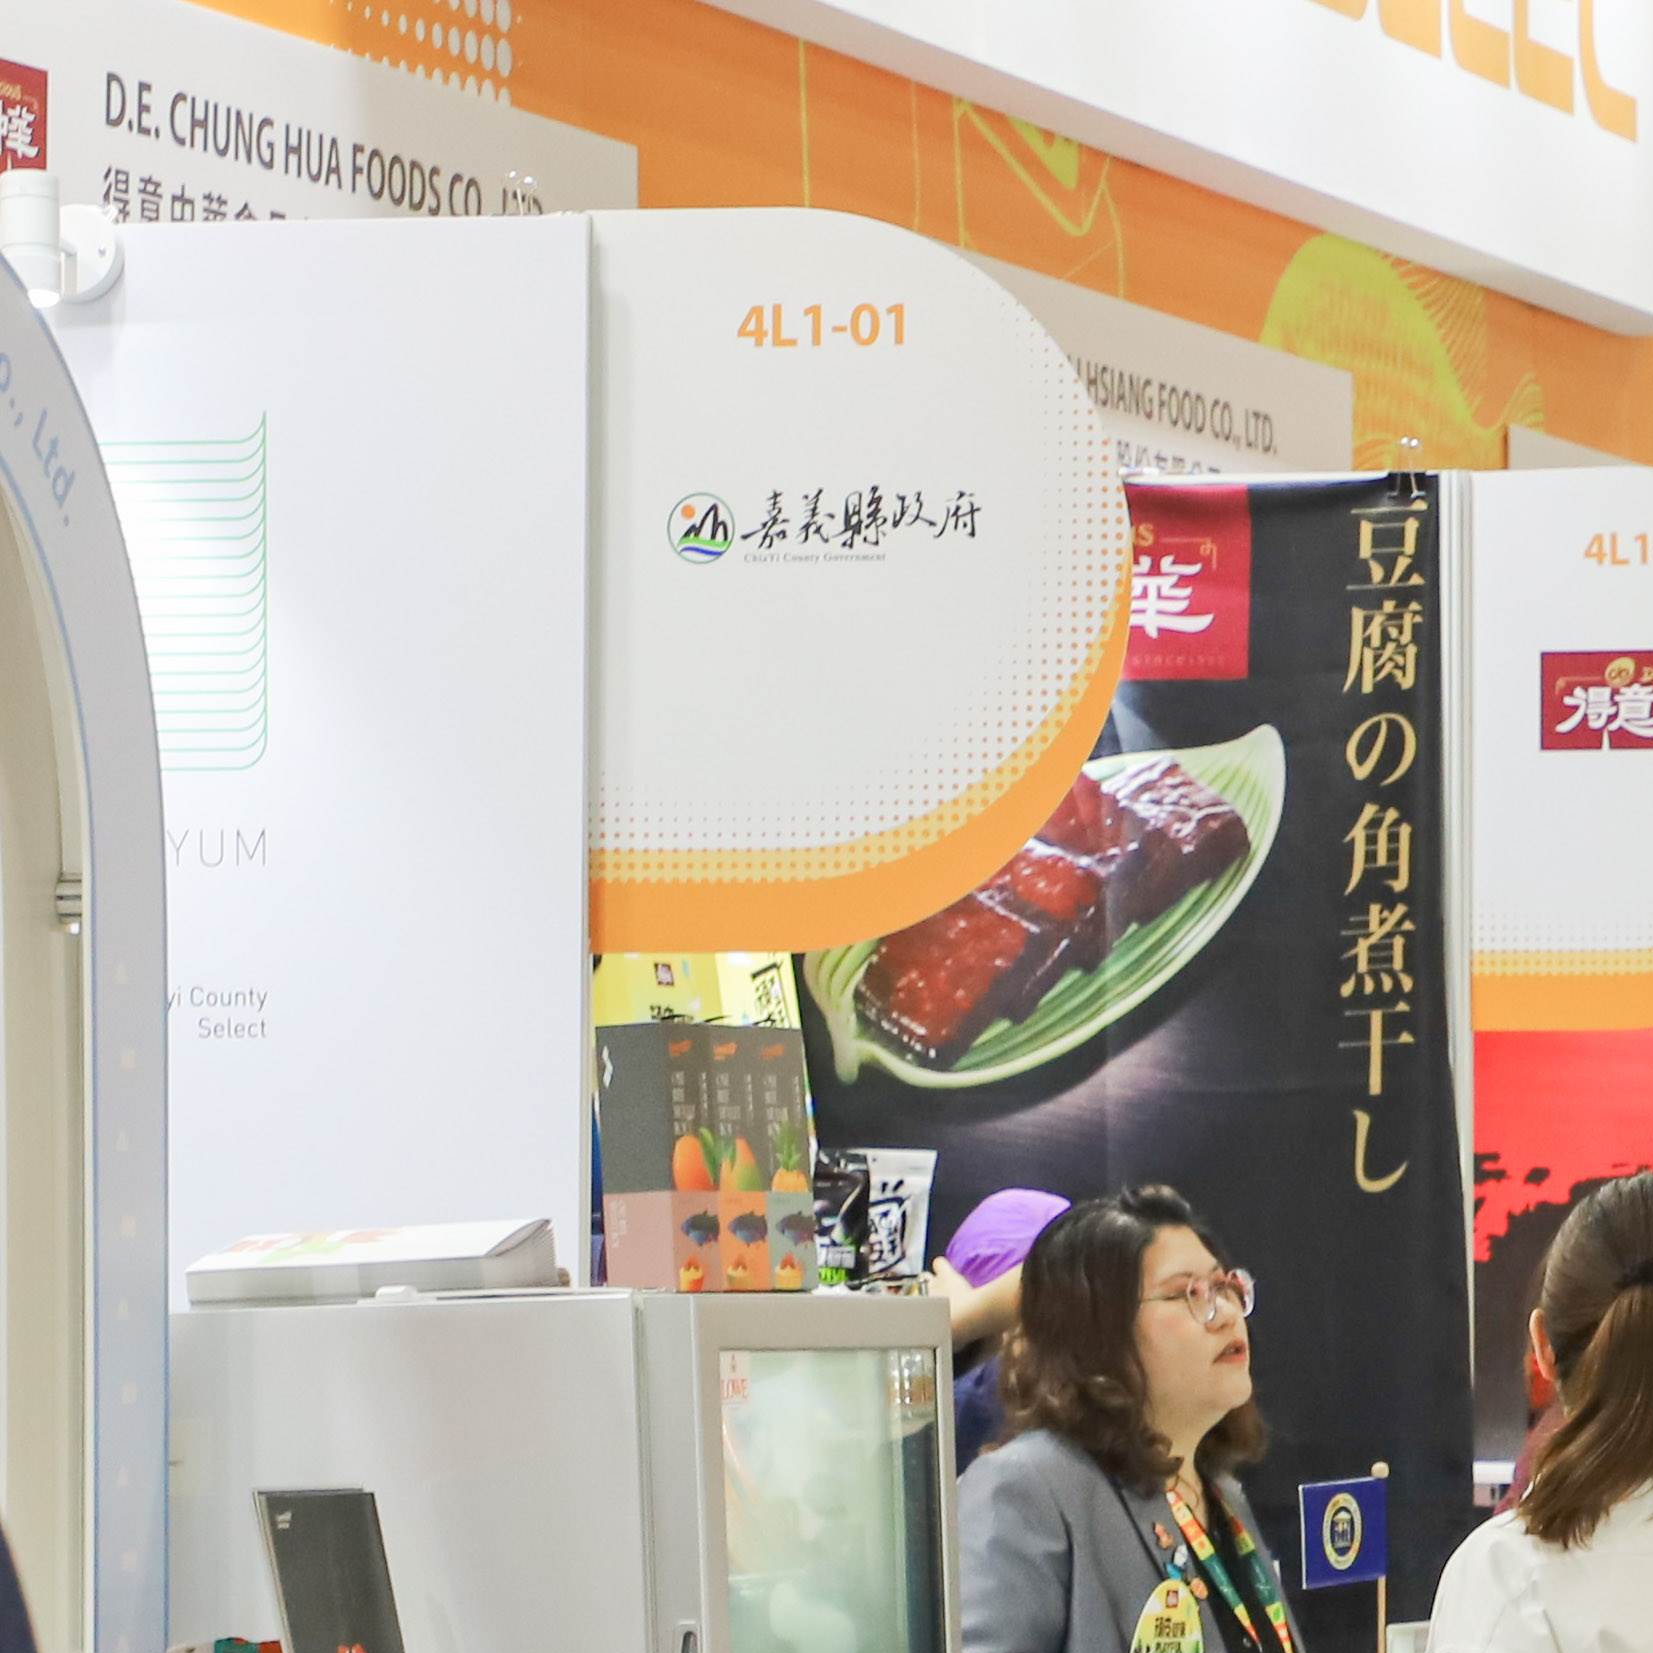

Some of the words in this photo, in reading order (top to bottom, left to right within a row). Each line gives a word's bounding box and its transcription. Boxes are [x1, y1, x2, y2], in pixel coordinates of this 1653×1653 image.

[105, 72, 160, 140] D.E.
[169, 91, 275, 171] CHUNG
[284, 123, 342, 190] HUA
[351, 142, 441, 217] FOODS
[736, 302, 906, 349] 4L1-01
[1158, 382, 1206, 434] FOOD
[1244, 408, 1277, 455] LTD.
[740, 484, 983, 549] 嘉義縣政府
[783, 552, 821, 564] County
[823, 551, 887, 563] Government
[190, 987, 269, 1013] County
[198, 1017, 267, 1039] Select
